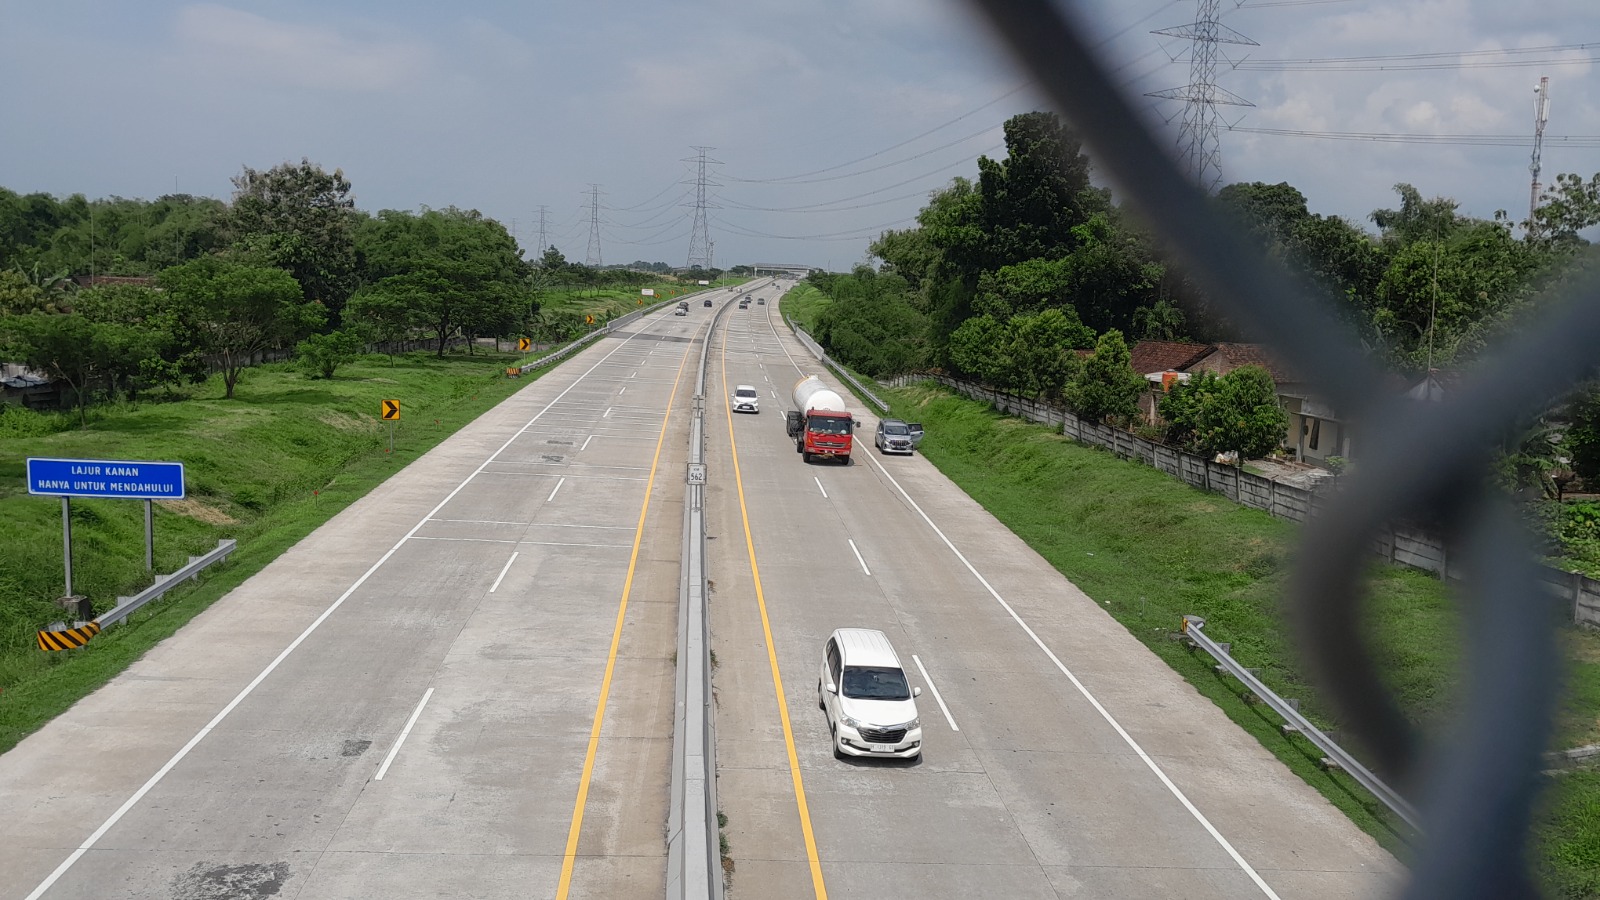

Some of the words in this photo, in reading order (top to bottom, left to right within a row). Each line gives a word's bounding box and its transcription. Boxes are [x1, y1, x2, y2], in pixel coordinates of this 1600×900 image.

[71, 466, 101, 475] LAJUR
[105, 467, 139, 476] KANAN
[690, 472, 703, 481] 562
[38, 480, 70, 489] HANYA
[74, 481, 106, 491] UNTUK
[110, 482, 173, 492] MENDAHULUI
